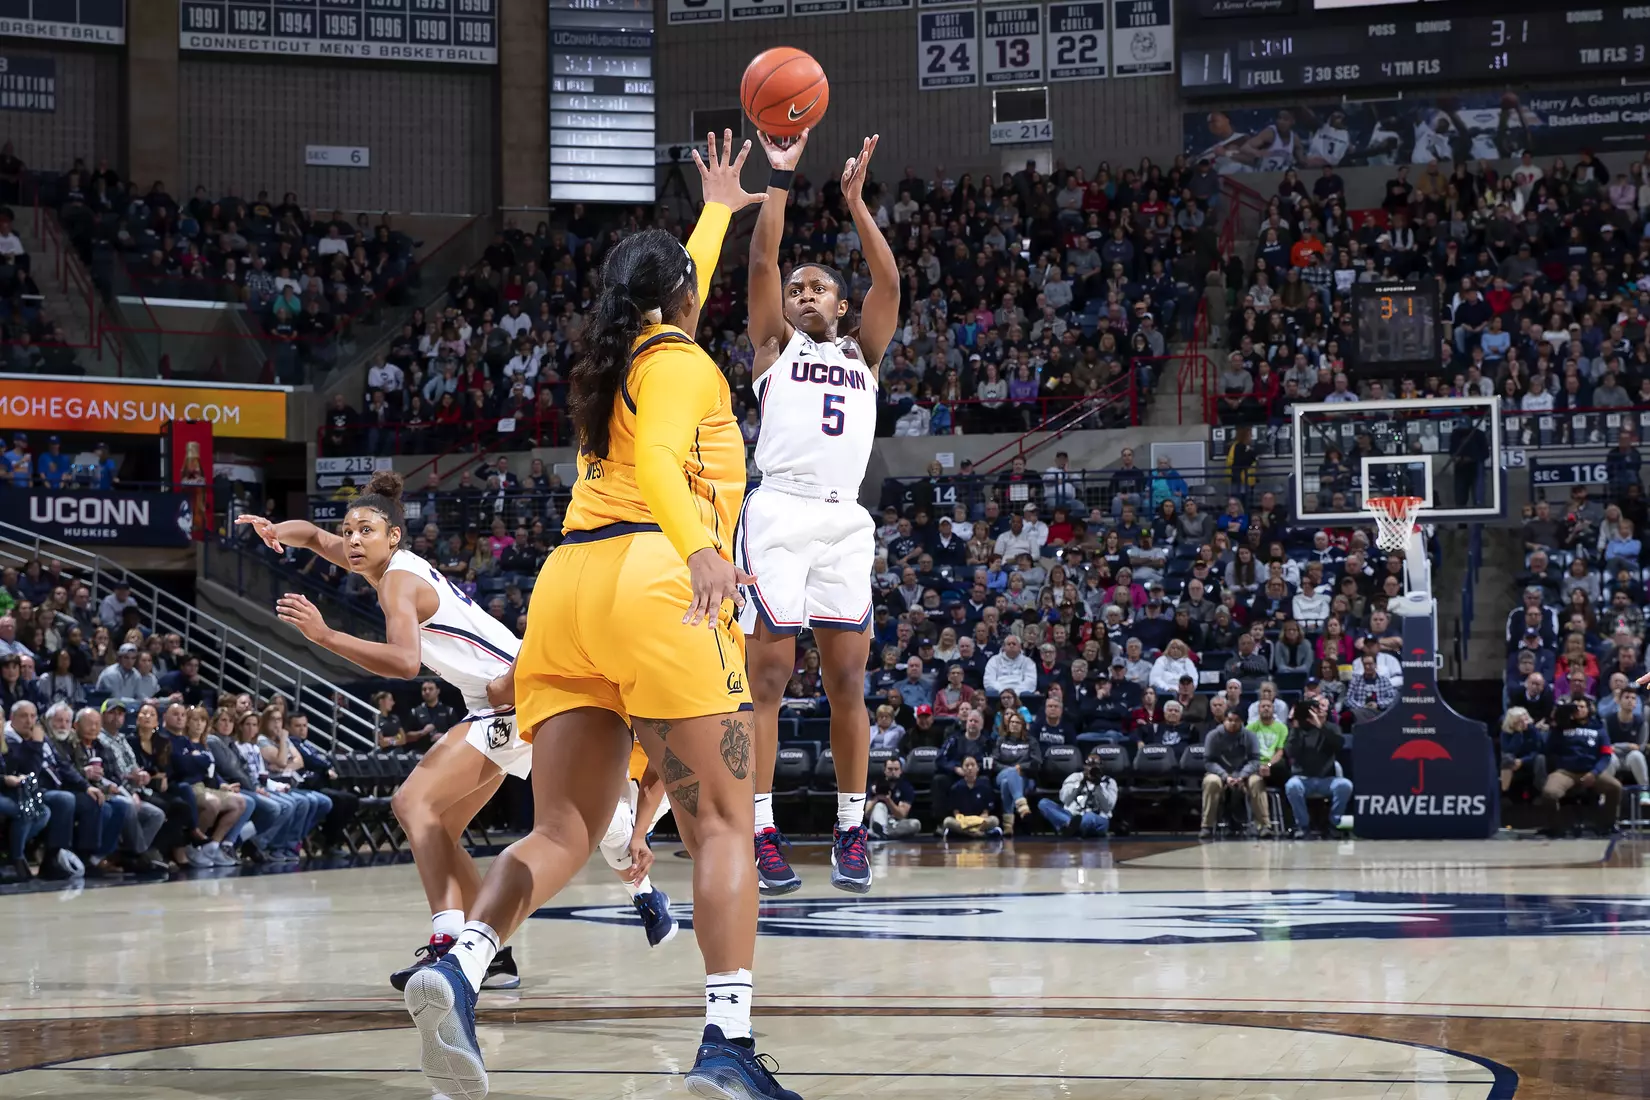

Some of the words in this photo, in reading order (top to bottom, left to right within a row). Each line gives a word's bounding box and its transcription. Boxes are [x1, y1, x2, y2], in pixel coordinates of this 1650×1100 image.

[188, 7, 220, 29] 1991
[234, 9, 266, 31] 1992
[279, 12, 312, 34] 1994
[325, 14, 357, 36] 1995
[370, 17, 402, 38] 1996
[1416, 20, 1451, 34] BONUS
[0, 21, 115, 41] BASKETBALL
[459, 21, 490, 42] 1999
[1368, 24, 1396, 36] POSS
[190, 36, 311, 52] CONNECTICUT
[320, 43, 371, 56] MEN'S
[380, 46, 488, 60] BASKETBALL
[927, 43, 970, 73] 24
[996, 38, 1030, 68] 13
[1058, 34, 1098, 64] 22
[1579, 48, 1600, 64] TM
[1603, 47, 1628, 63] FLS
[1634, 44, 1645, 62] 3
[1254, 70, 1284, 85] FULL
[1315, 66, 1331, 81] 30
[1334, 64, 1360, 80] SEC
[1395, 60, 1414, 76] TM
[1417, 59, 1440, 74] FLS
[1530, 98, 1568, 111] Harry
[1570, 96, 1585, 108] A.
[1588, 92, 1640, 107] Gampel
[1548, 110, 1618, 126] Basketball
[992, 129, 1012, 138] SEC
[1020, 124, 1051, 138] 214
[308, 151, 328, 160] SEC
[351, 150, 361, 163] 6
[790, 362, 867, 391] UCONN
[822, 393, 845, 437] 5
[317, 461, 336, 470] SEC
[345, 458, 372, 472] 213
[584, 459, 604, 480] WEST
[1534, 470, 1560, 481] SEC
[1571, 465, 1608, 482] 116
[30, 496, 149, 526] UCONN
[315, 508, 336, 517] SEC
[64, 528, 118, 538] HUSKIES
[727, 671, 743, 695] Cal
[1355, 794, 1486, 816] TRAVELERS
